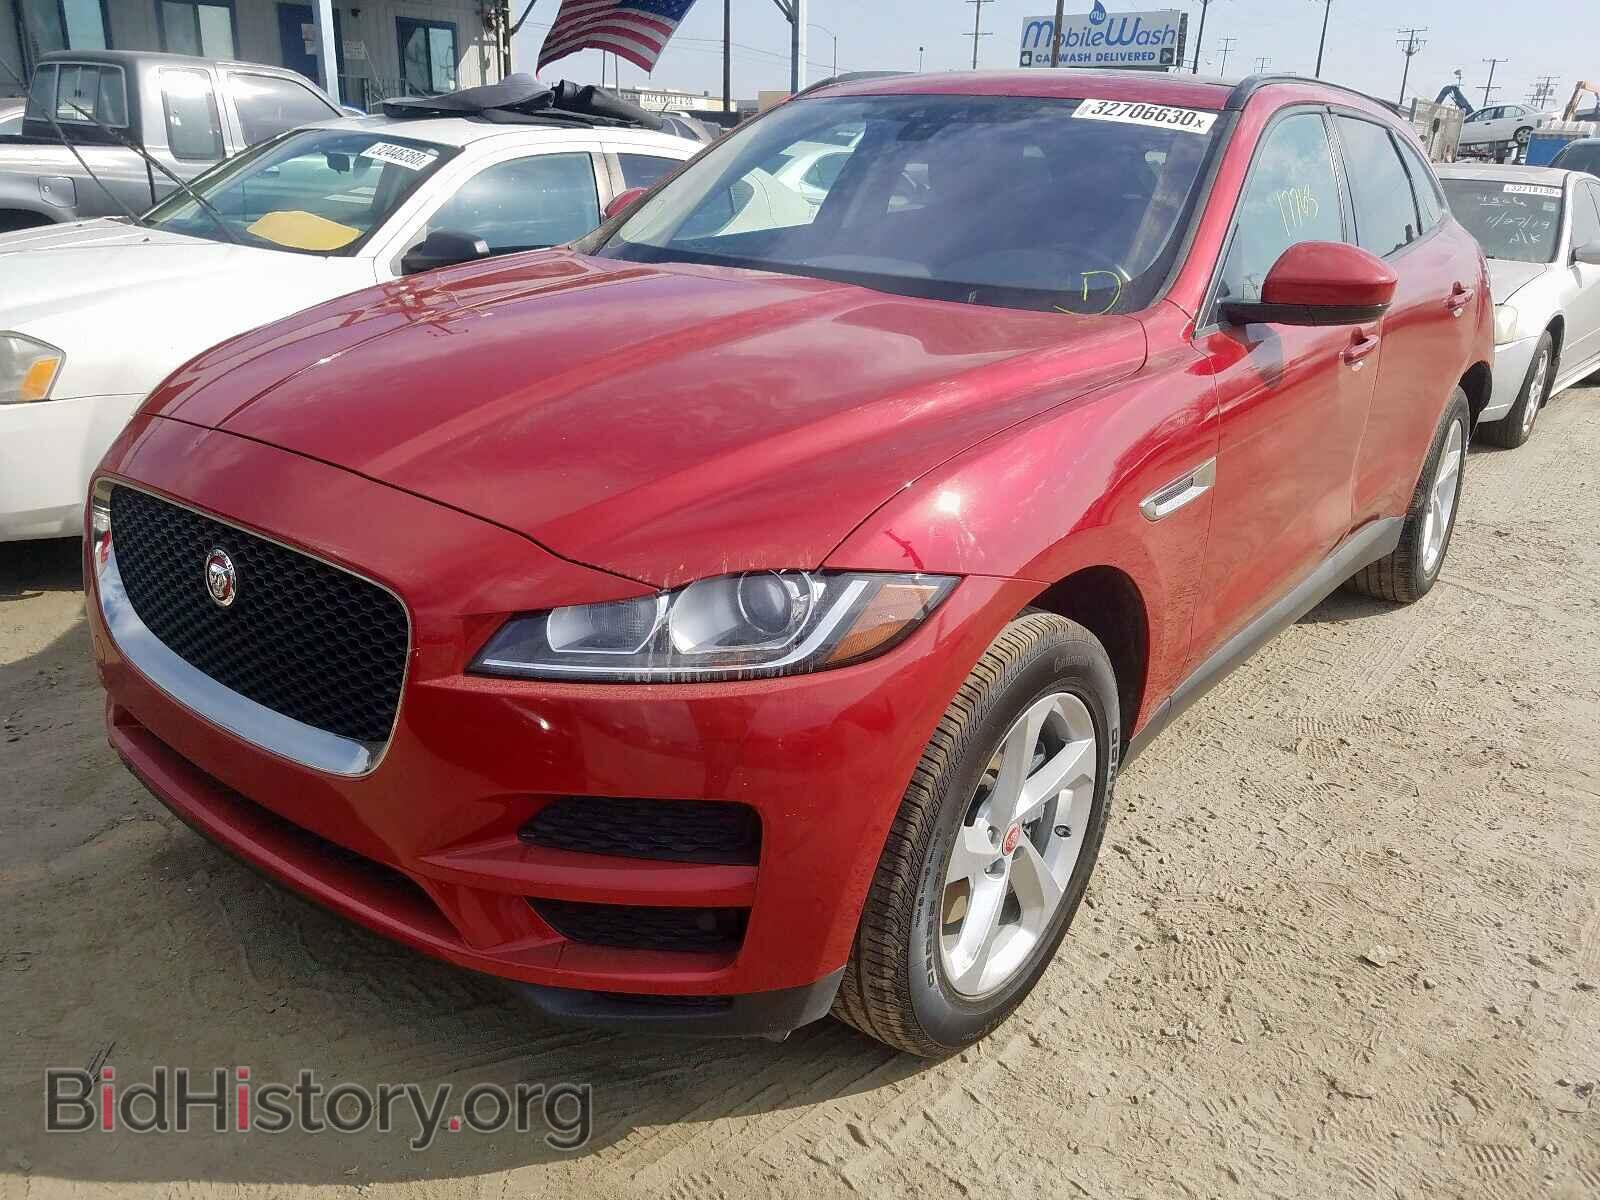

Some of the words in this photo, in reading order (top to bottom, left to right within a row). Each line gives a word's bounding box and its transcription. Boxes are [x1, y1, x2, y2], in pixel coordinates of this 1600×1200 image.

[1035, 53, 1053, 63] CA
[1058, 51, 1091, 63] WASH
[1096, 51, 1156, 62] DELIVERED
